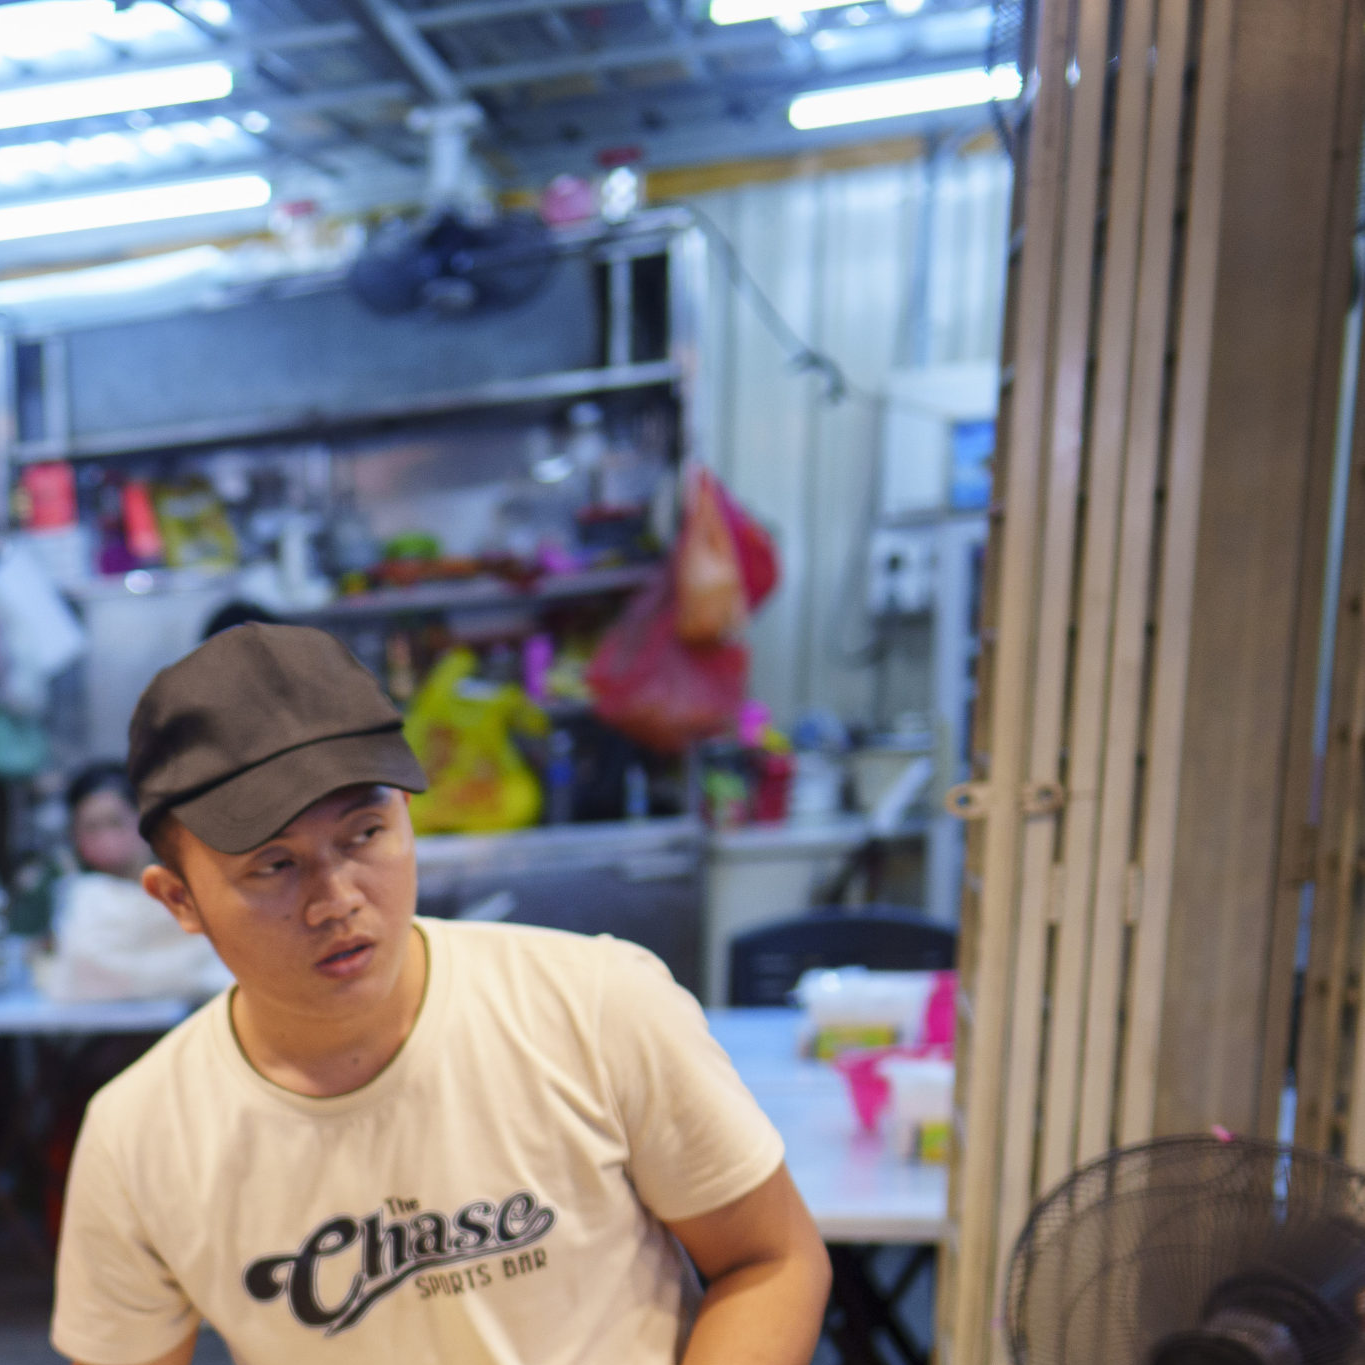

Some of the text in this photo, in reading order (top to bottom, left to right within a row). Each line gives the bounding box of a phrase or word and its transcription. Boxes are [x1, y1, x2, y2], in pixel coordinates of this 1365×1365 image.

[384, 1196, 420, 1217] The
[242, 1190, 558, 1337] Chase
[415, 1247, 549, 1300] SPORTS BAR
